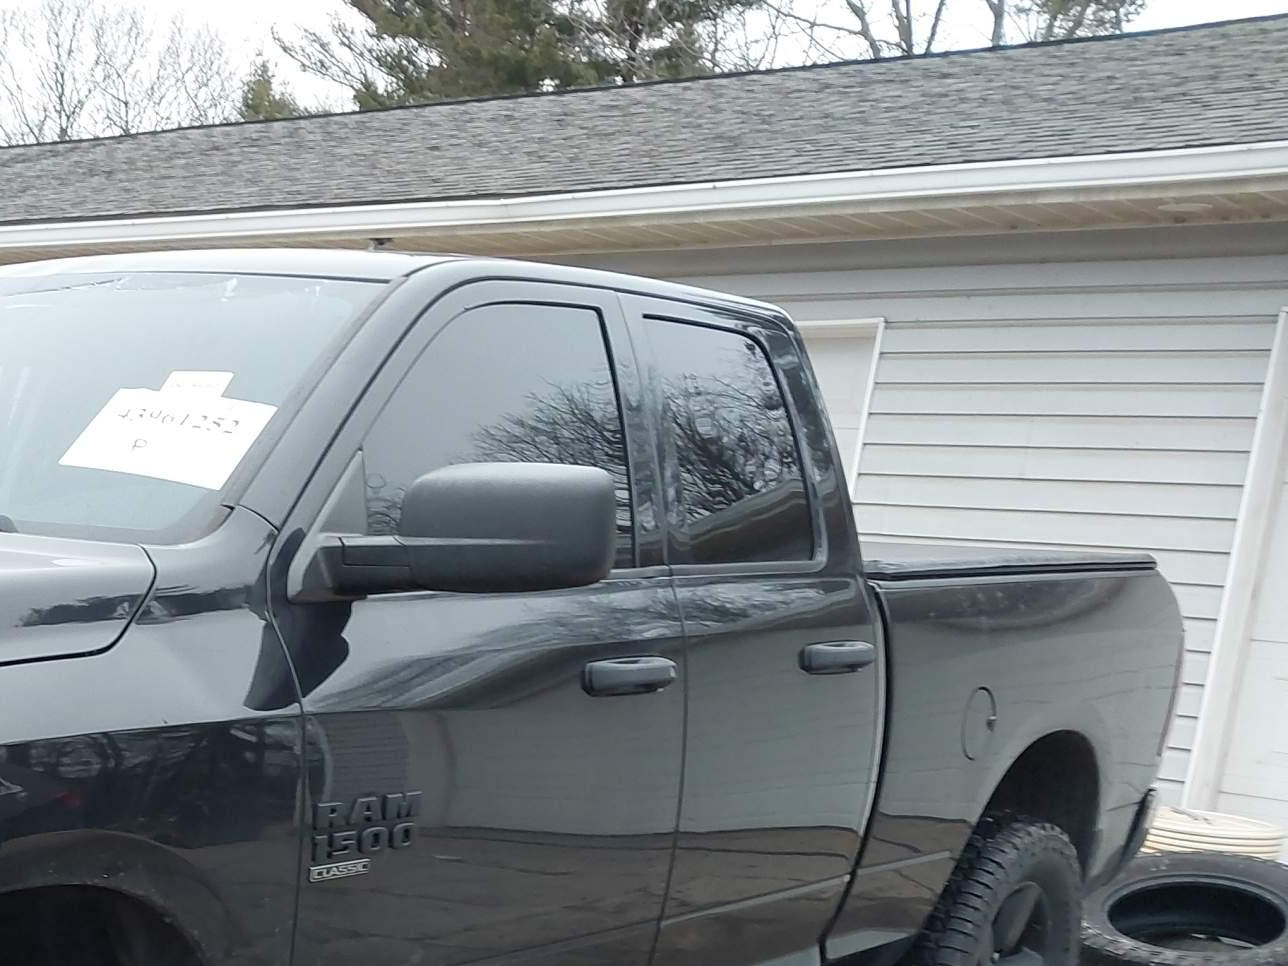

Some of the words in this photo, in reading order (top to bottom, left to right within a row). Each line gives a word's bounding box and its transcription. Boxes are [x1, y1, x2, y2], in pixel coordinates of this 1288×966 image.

[314, 791, 424, 829] RAM
[312, 821, 417, 863] 1500
[313, 863, 369, 879] CLASSIC
